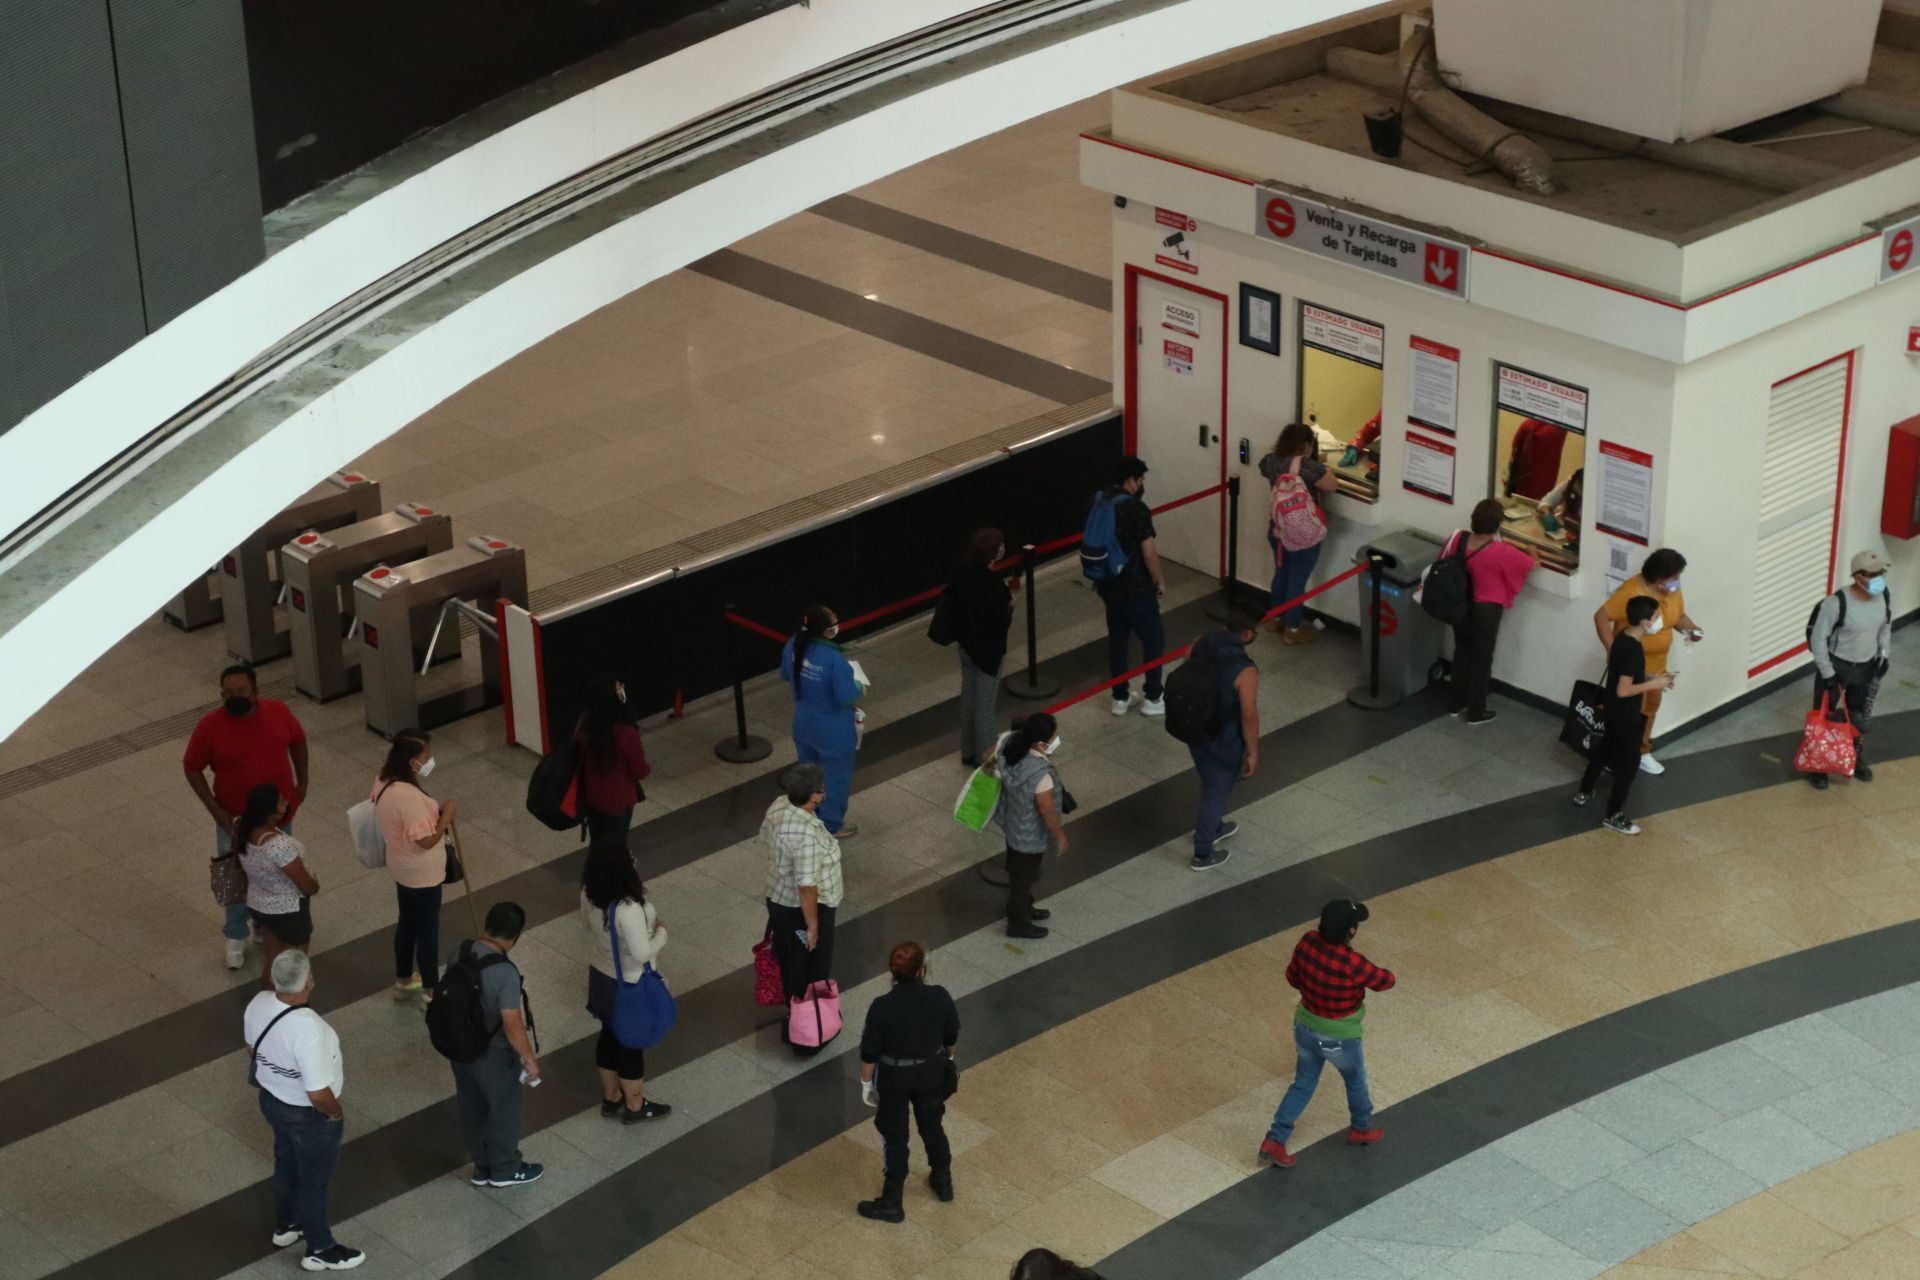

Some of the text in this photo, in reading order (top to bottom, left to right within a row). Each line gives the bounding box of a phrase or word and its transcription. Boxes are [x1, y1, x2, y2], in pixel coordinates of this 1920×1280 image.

[1306, 208, 1416, 254] Venta y Recarga
[1322, 234, 1398, 268] de Tarjetas
[1166, 305, 1195, 320] ACCESO
[1510, 371, 1584, 401] ESTIMADO USUARIO
